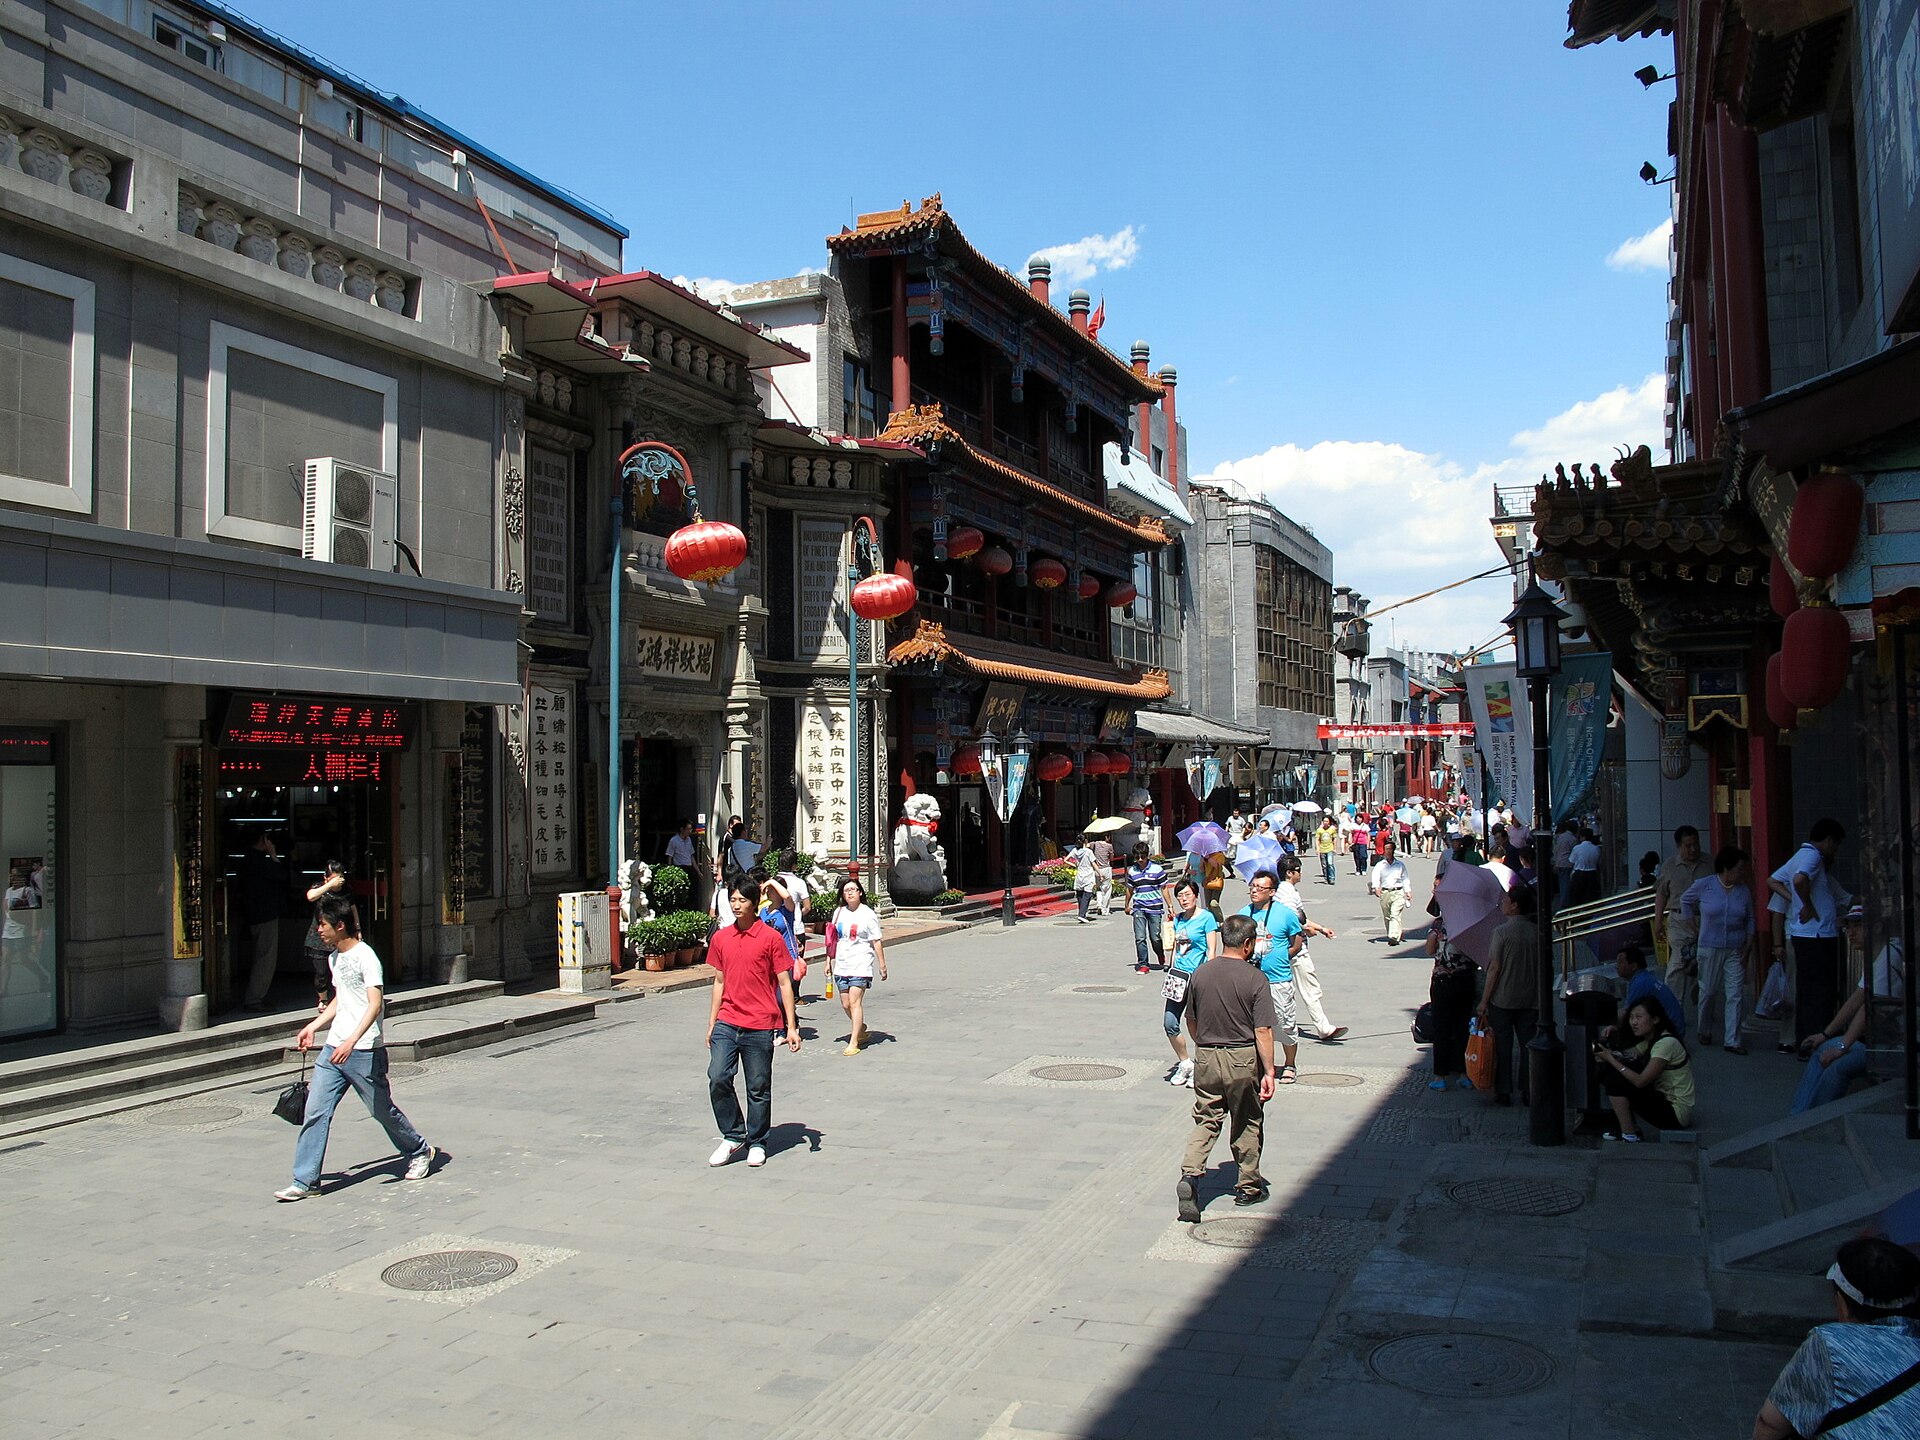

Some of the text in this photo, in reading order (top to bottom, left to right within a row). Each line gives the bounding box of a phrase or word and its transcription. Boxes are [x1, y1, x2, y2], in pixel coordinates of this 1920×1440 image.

[549, 502, 555, 517] OF
[557, 504, 566, 520] THE
[803, 545, 809, 557] OF
[811, 545, 828, 558] FINEST
[803, 575, 827, 587] COLLARS
[803, 620, 831, 632] SELECTION
[1585, 748, 1595, 777] OPERA
[1510, 775, 1519, 808] FESTIVAL
